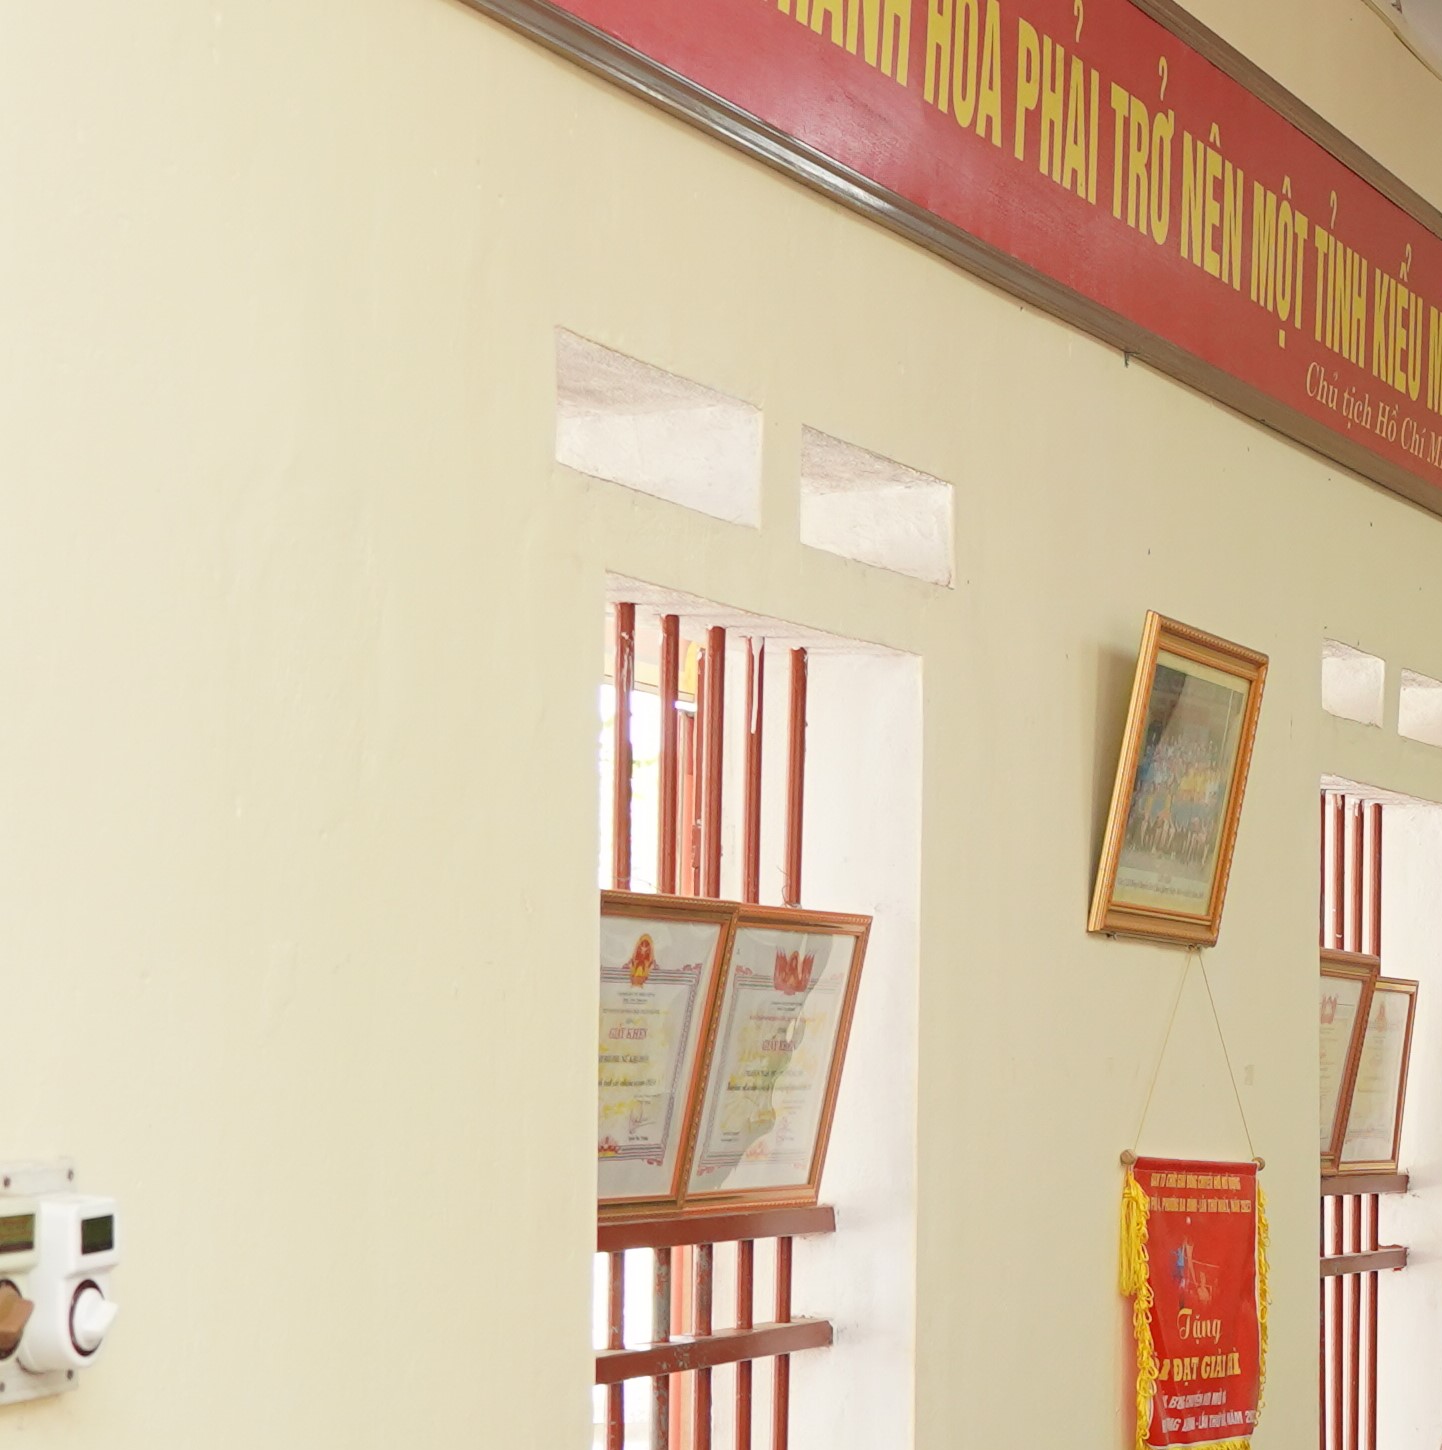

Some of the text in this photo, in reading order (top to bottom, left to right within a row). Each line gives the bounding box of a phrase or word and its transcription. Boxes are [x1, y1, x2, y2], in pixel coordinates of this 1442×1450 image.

[1014, 0, 1099, 205] PHẢI
[1111, 56, 1175, 245] TRỞ
[1181, 122, 1243, 291] NÊN
[1251, 175, 1308, 348] MỘT
[1315, 190, 1368, 368] TỈNH
[1373, 243, 1423, 401] KIỂU
[1306, 361, 1339, 412] Chủ
[1342, 387, 1372, 430] tịch
[1376, 402, 1398, 442] Hồ
[1401, 417, 1427, 459] Chí
[1177, 1308, 1223, 1344] Tặng
[1173, 1356, 1200, 1387] ĐẠT
[1200, 1348, 1227, 1380] GIẢI
